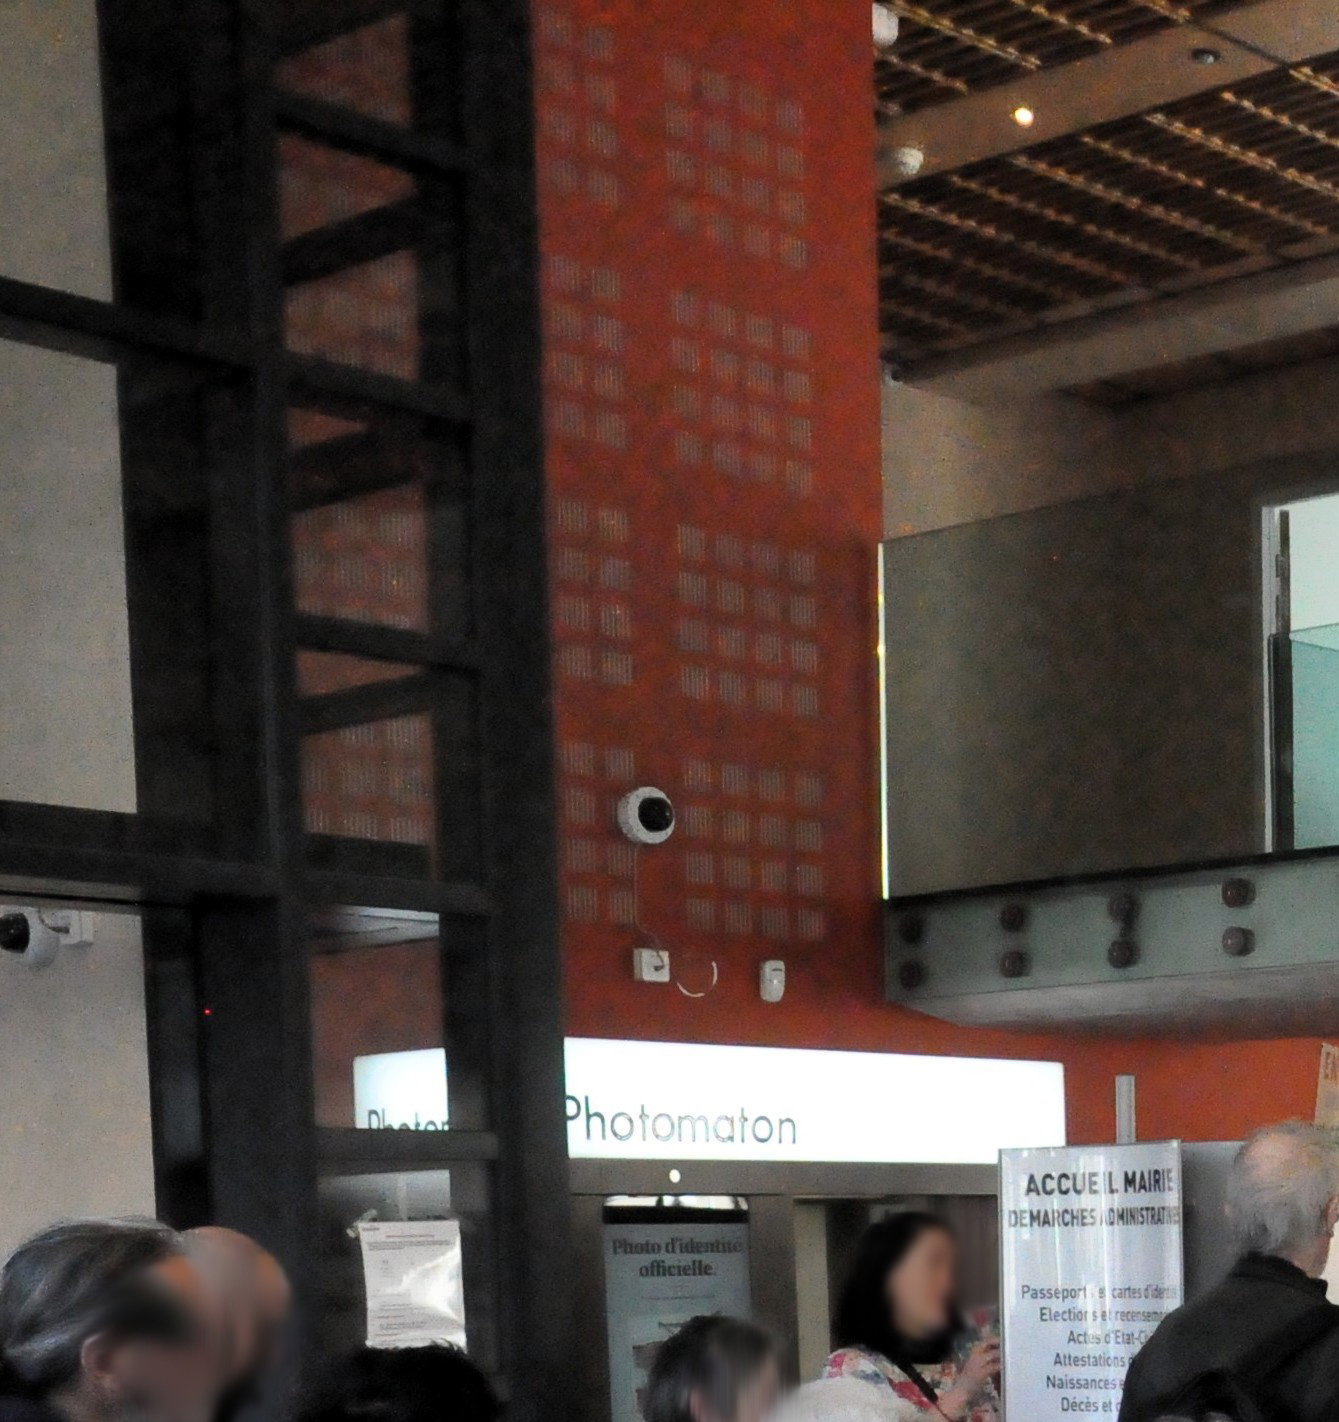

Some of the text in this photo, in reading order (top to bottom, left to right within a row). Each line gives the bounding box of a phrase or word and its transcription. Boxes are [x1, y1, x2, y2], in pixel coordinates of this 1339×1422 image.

[565, 1095, 797, 1144] Photomaton
[1024, 1168, 1174, 1197] ACCUEIL MAIRIE
[612, 1238, 662, 1255] Photo
[1021, 1284, 1091, 1302] Passeport
[1067, 1330, 1101, 1345] Actes
[1053, 1352, 1126, 1367] Attestations
[1046, 1375, 1117, 1389] Naissances
[1101, 1400, 1113, 1412] et
